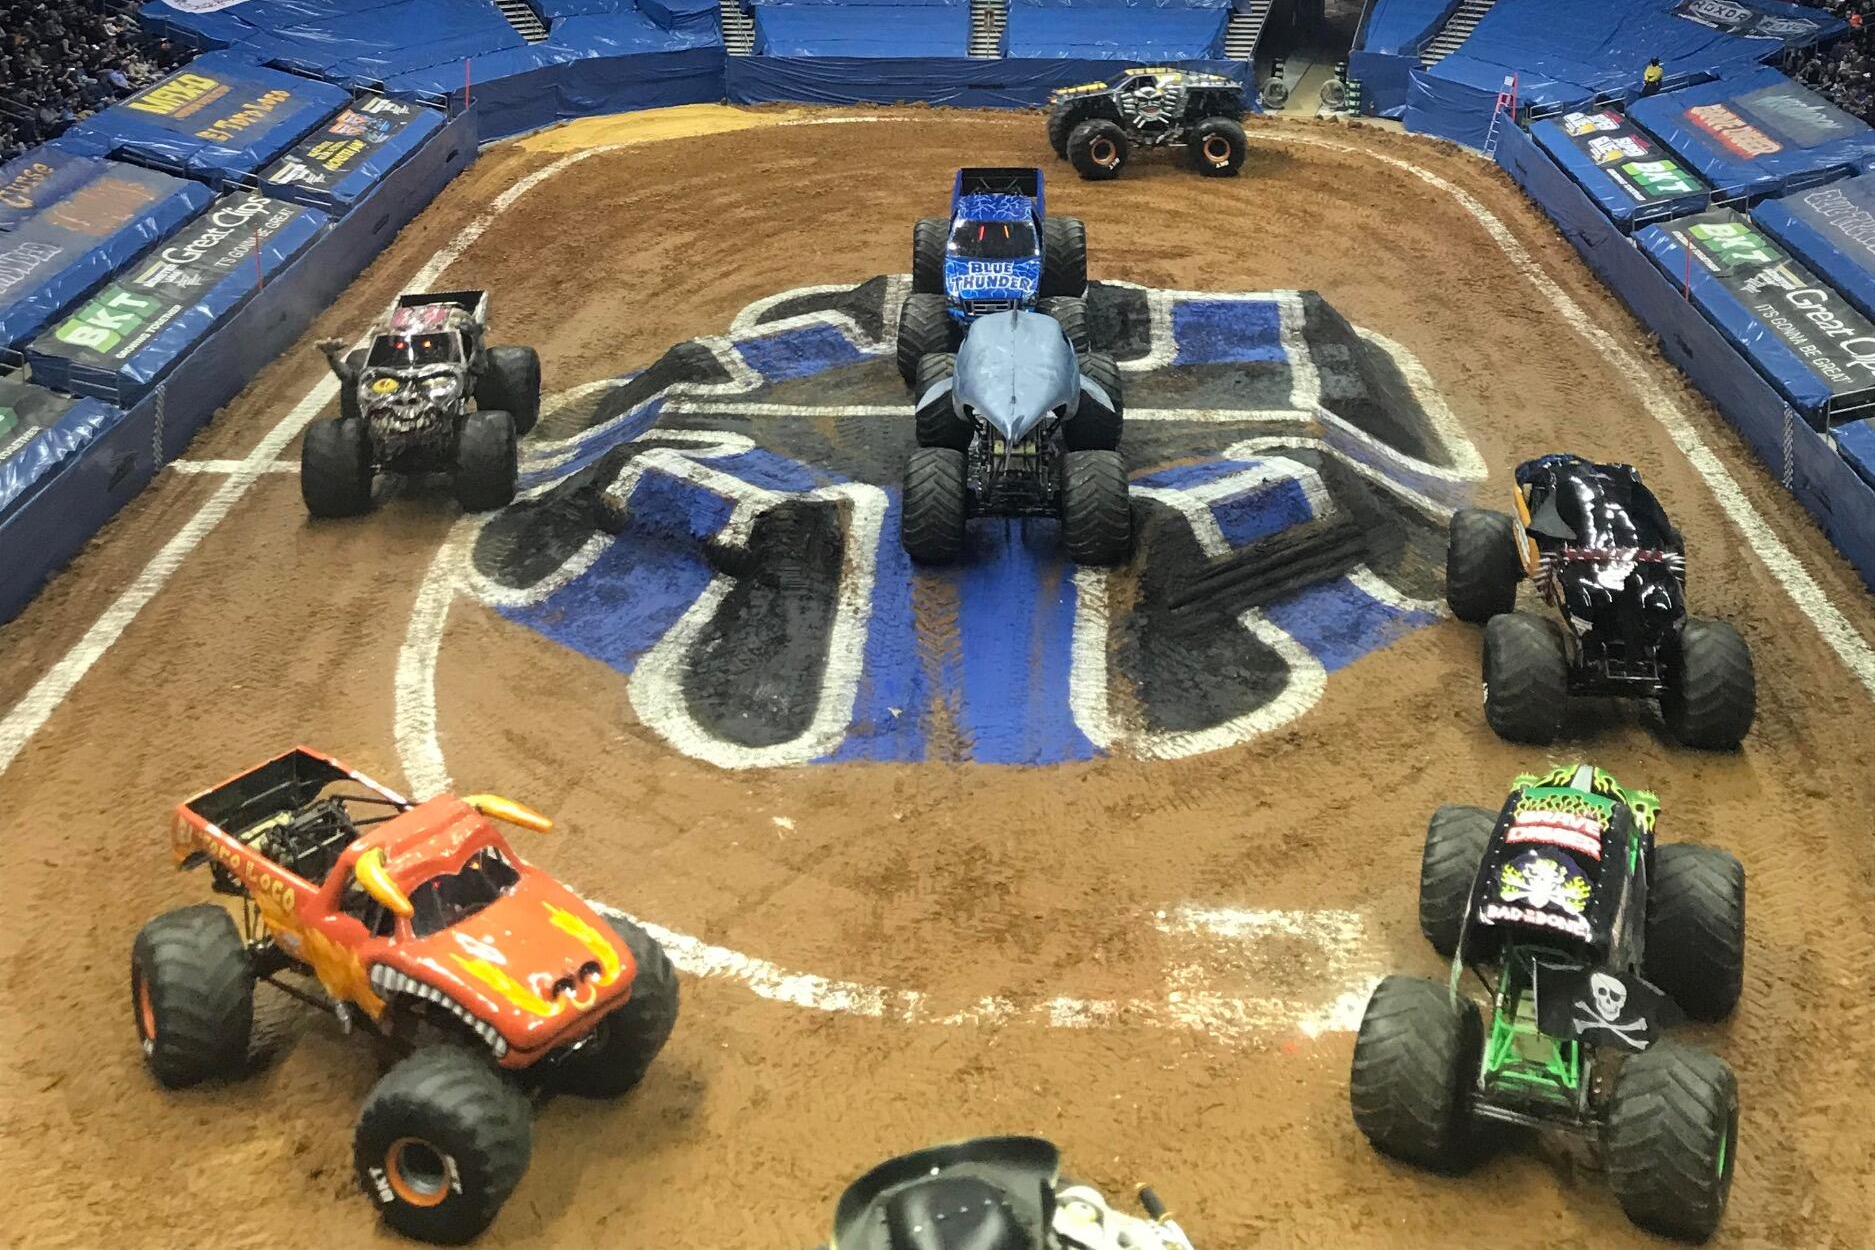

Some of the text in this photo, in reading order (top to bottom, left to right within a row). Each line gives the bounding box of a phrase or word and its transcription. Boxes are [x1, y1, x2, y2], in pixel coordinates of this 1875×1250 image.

[1630, 161, 1694, 192] BKT
[162, 196, 272, 264] Great Clips
[265, 207, 294, 229] GREAT
[1702, 223, 1772, 263] BKT
[951, 276, 1032, 294] THUNDER
[968, 261, 1014, 275] BLUE
[64, 292, 150, 349] BKT
[1785, 289, 1875, 377] Great Clip
[1754, 303, 1850, 384] IT'S GONNA BE GREAT
[1487, 904, 1523, 921] BAD
[368, 1167, 395, 1203] BKT
